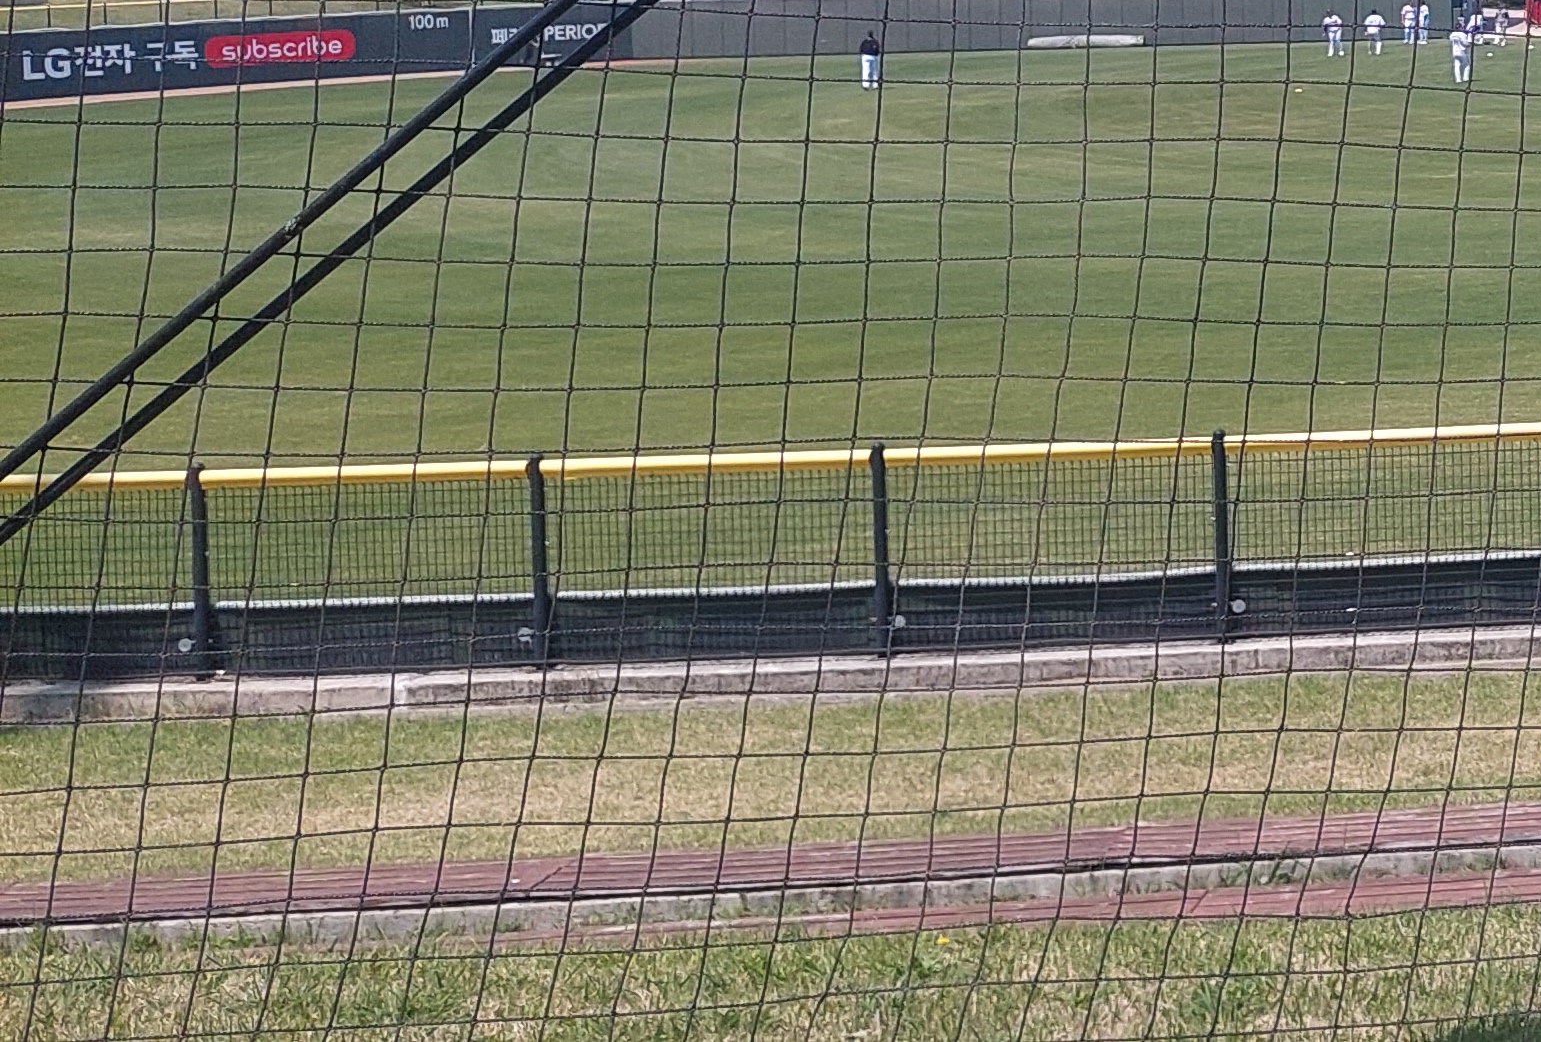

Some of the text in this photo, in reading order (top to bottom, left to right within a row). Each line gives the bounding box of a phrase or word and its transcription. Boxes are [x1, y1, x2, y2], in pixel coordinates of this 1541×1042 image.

[22, 34, 343, 81] LG전자 구독 subscribe
